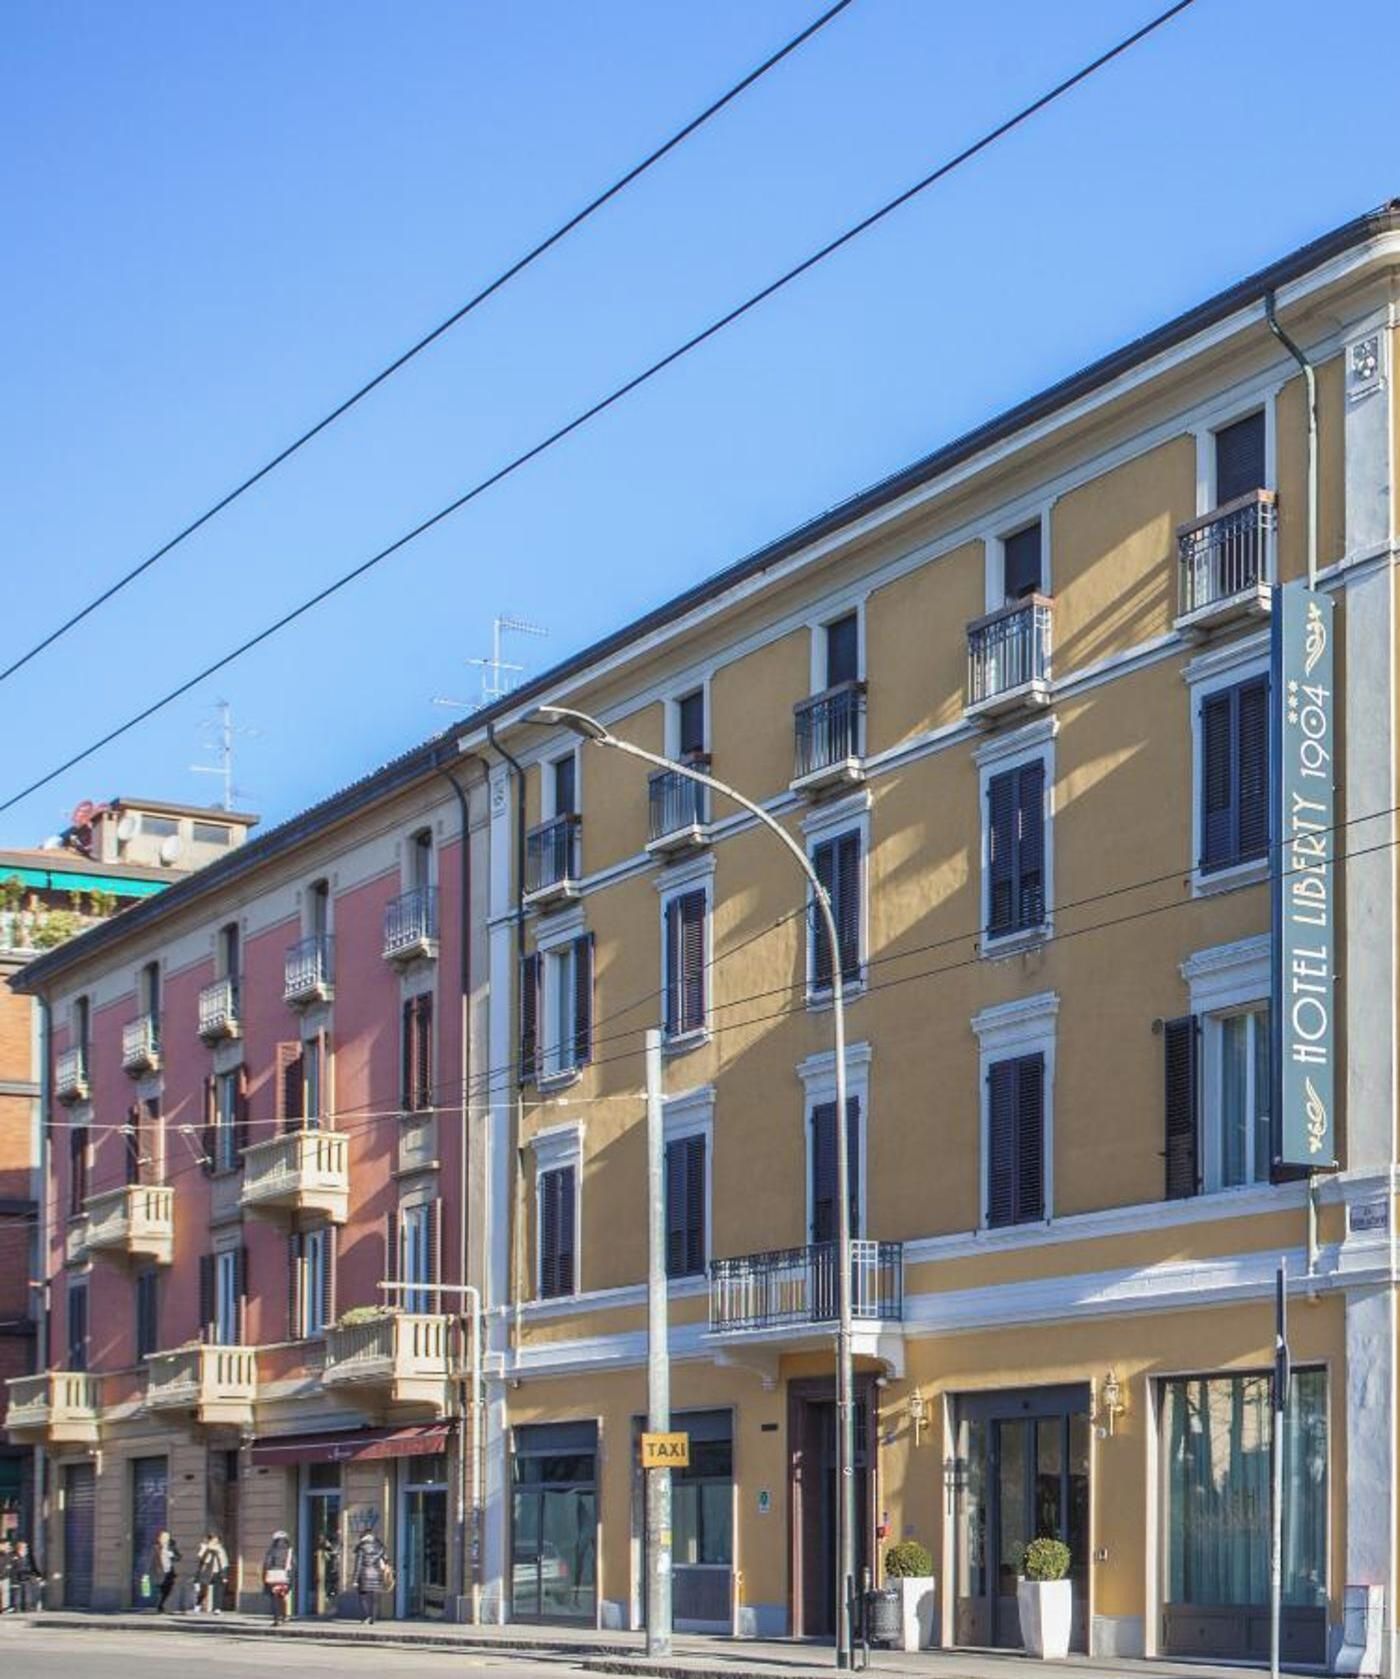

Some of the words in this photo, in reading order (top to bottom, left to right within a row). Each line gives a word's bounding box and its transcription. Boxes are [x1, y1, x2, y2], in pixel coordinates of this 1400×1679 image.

[1300, 684, 1330, 778] 1904
[1292, 791, 1326, 926] LIBERTY
[1292, 945, 1327, 1063] HOTEL
[646, 1442, 686, 1457] TAXI
